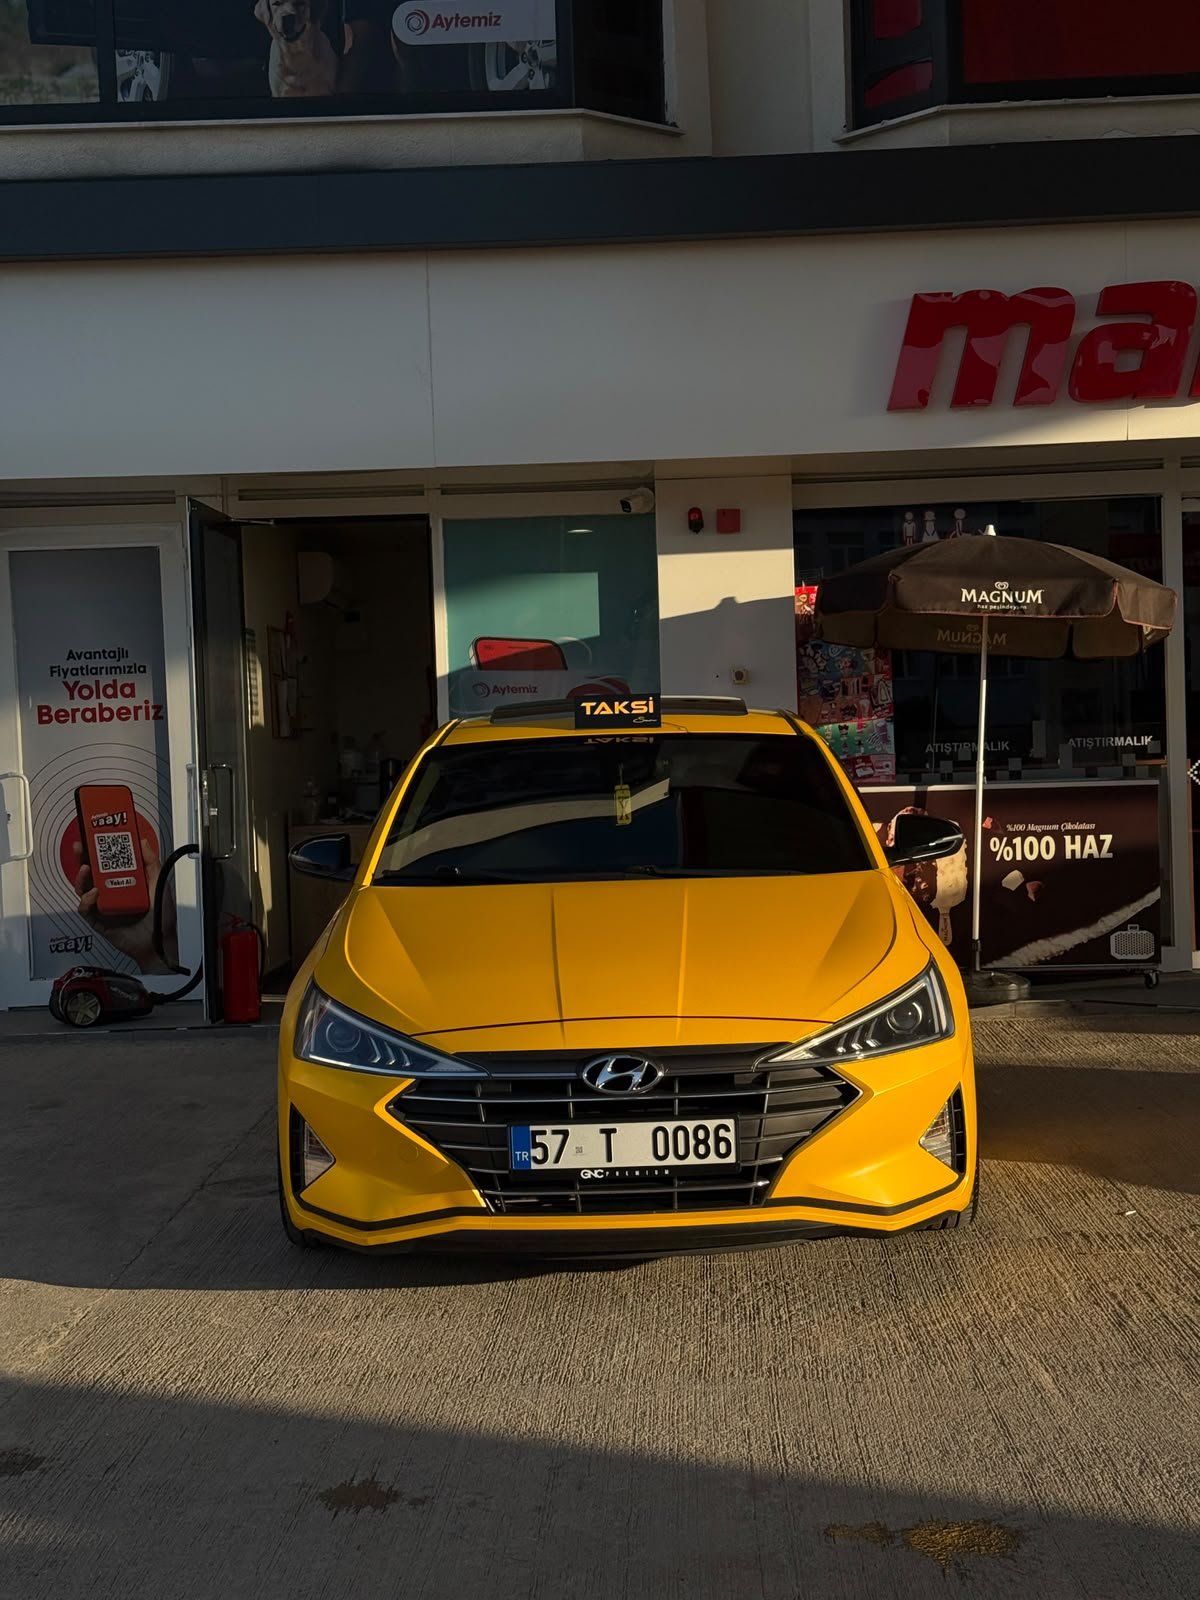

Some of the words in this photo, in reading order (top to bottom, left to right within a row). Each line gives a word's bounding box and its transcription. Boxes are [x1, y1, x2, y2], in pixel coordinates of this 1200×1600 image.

[431, 11, 502, 32] Aytemiz
[887, 281, 1200, 411] ma
[960, 588, 1043, 604] MAGNUM
[66, 647, 129, 662] Avantajlı
[49, 663, 147, 679] Fiyatlarımızla
[62, 679, 136, 700] Yolda
[492, 684, 538, 695] Aytemiz
[37, 700, 164, 725] Beraberiz
[1026, 823, 1059, 833] Magnum
[1060, 821, 1096, 833] Çikolatası
[989, 835, 1056, 862] %100
[1063, 834, 1114, 860] HAZ
[49, 935, 93, 954] vaay!
[531, 1129, 570, 1165] 57
[599, 1128, 617, 1163] T
[652, 1123, 732, 1161] 0086
[515, 1151, 529, 1162] TR
[580, 1169, 604, 1179] GNC
